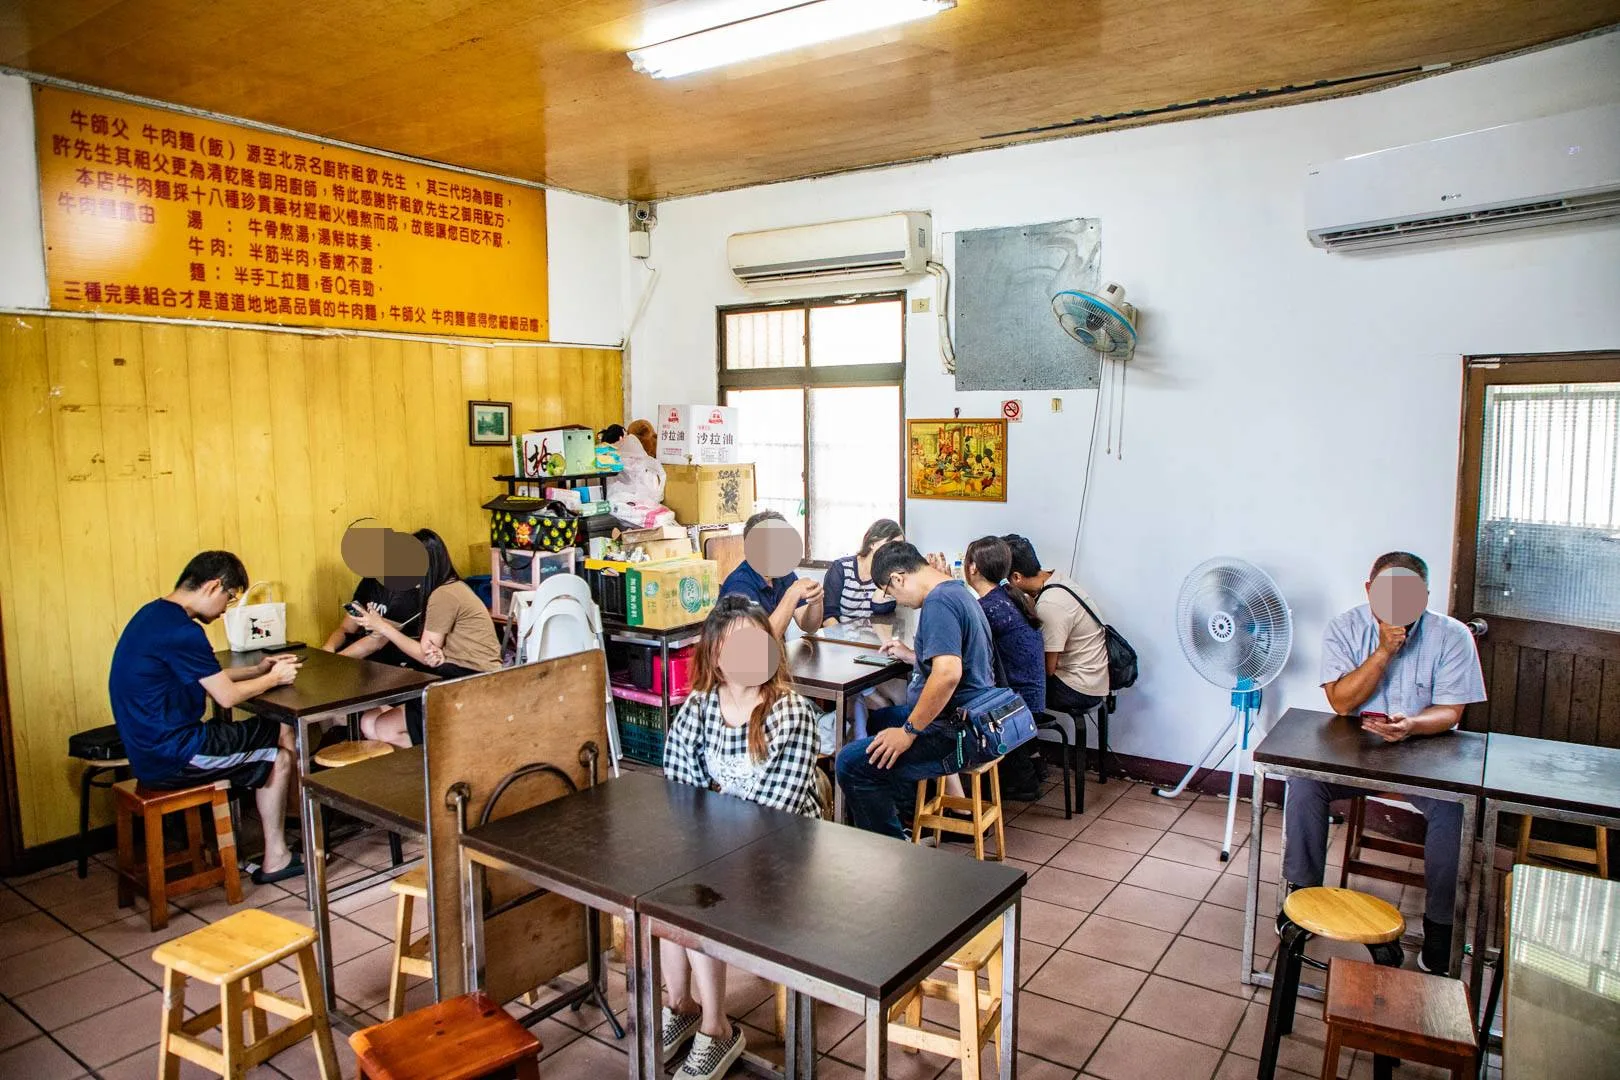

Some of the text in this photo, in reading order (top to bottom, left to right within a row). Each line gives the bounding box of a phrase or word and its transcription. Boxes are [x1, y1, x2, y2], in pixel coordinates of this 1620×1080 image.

[70, 109, 130, 141] 牛師父
[661, 430, 685, 441] 沙拉油
[697, 432, 734, 445] 沙拉油
